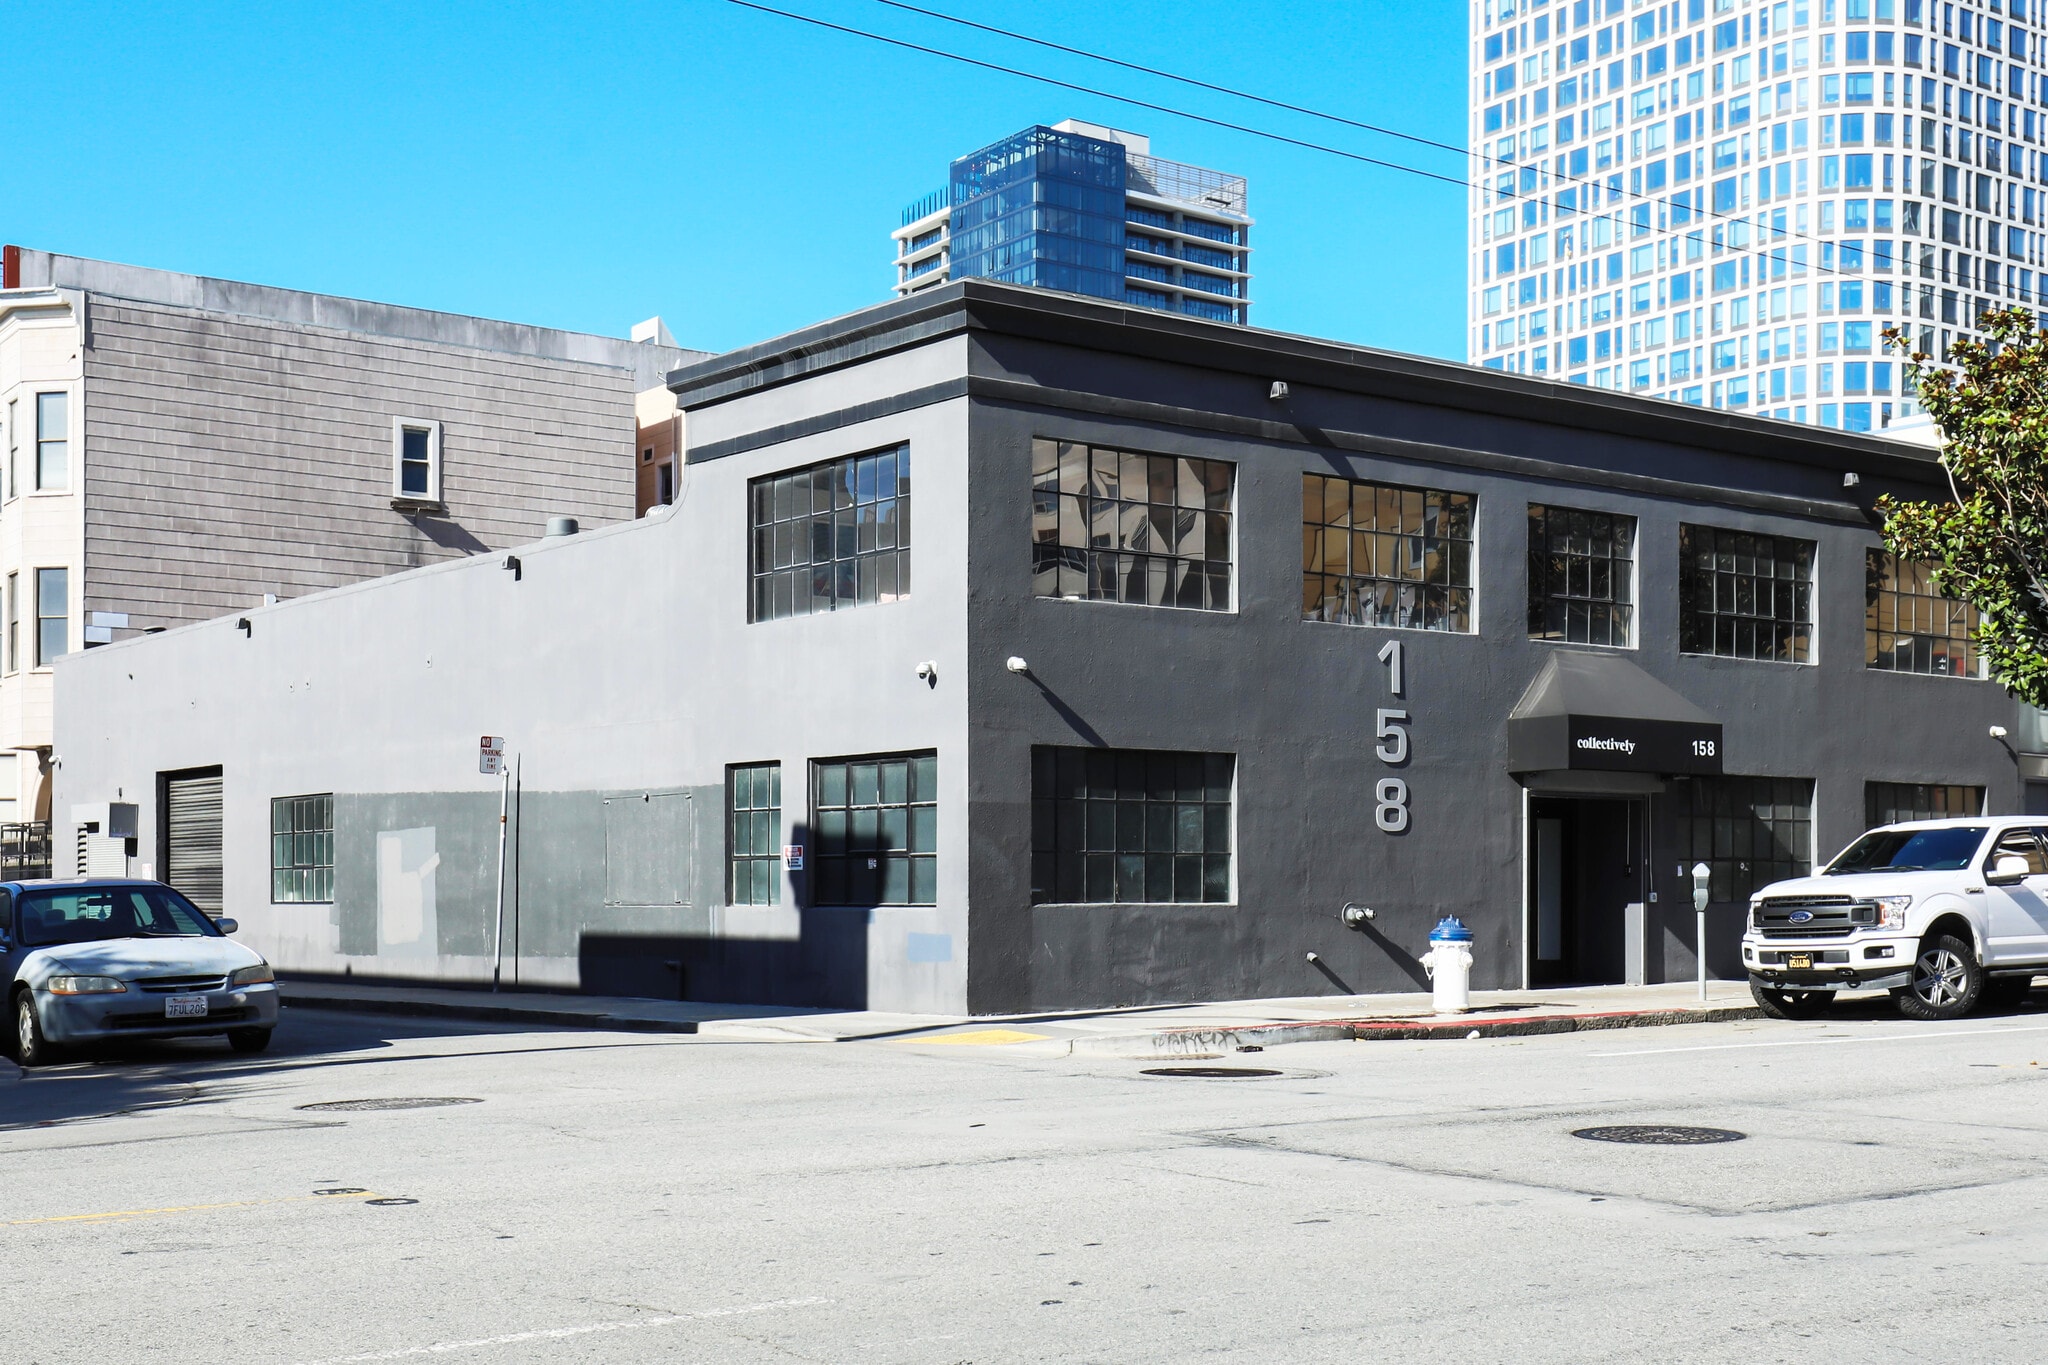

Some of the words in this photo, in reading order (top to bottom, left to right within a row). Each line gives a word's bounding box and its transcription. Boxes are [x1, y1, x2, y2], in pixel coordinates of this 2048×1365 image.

[482, 737, 491, 746] NO
[1577, 736, 1636, 755] collectively
[482, 749, 502, 757] PARKING
[1692, 740, 1715, 756] 158
[169, 1004, 206, 1016] 7FUL205
